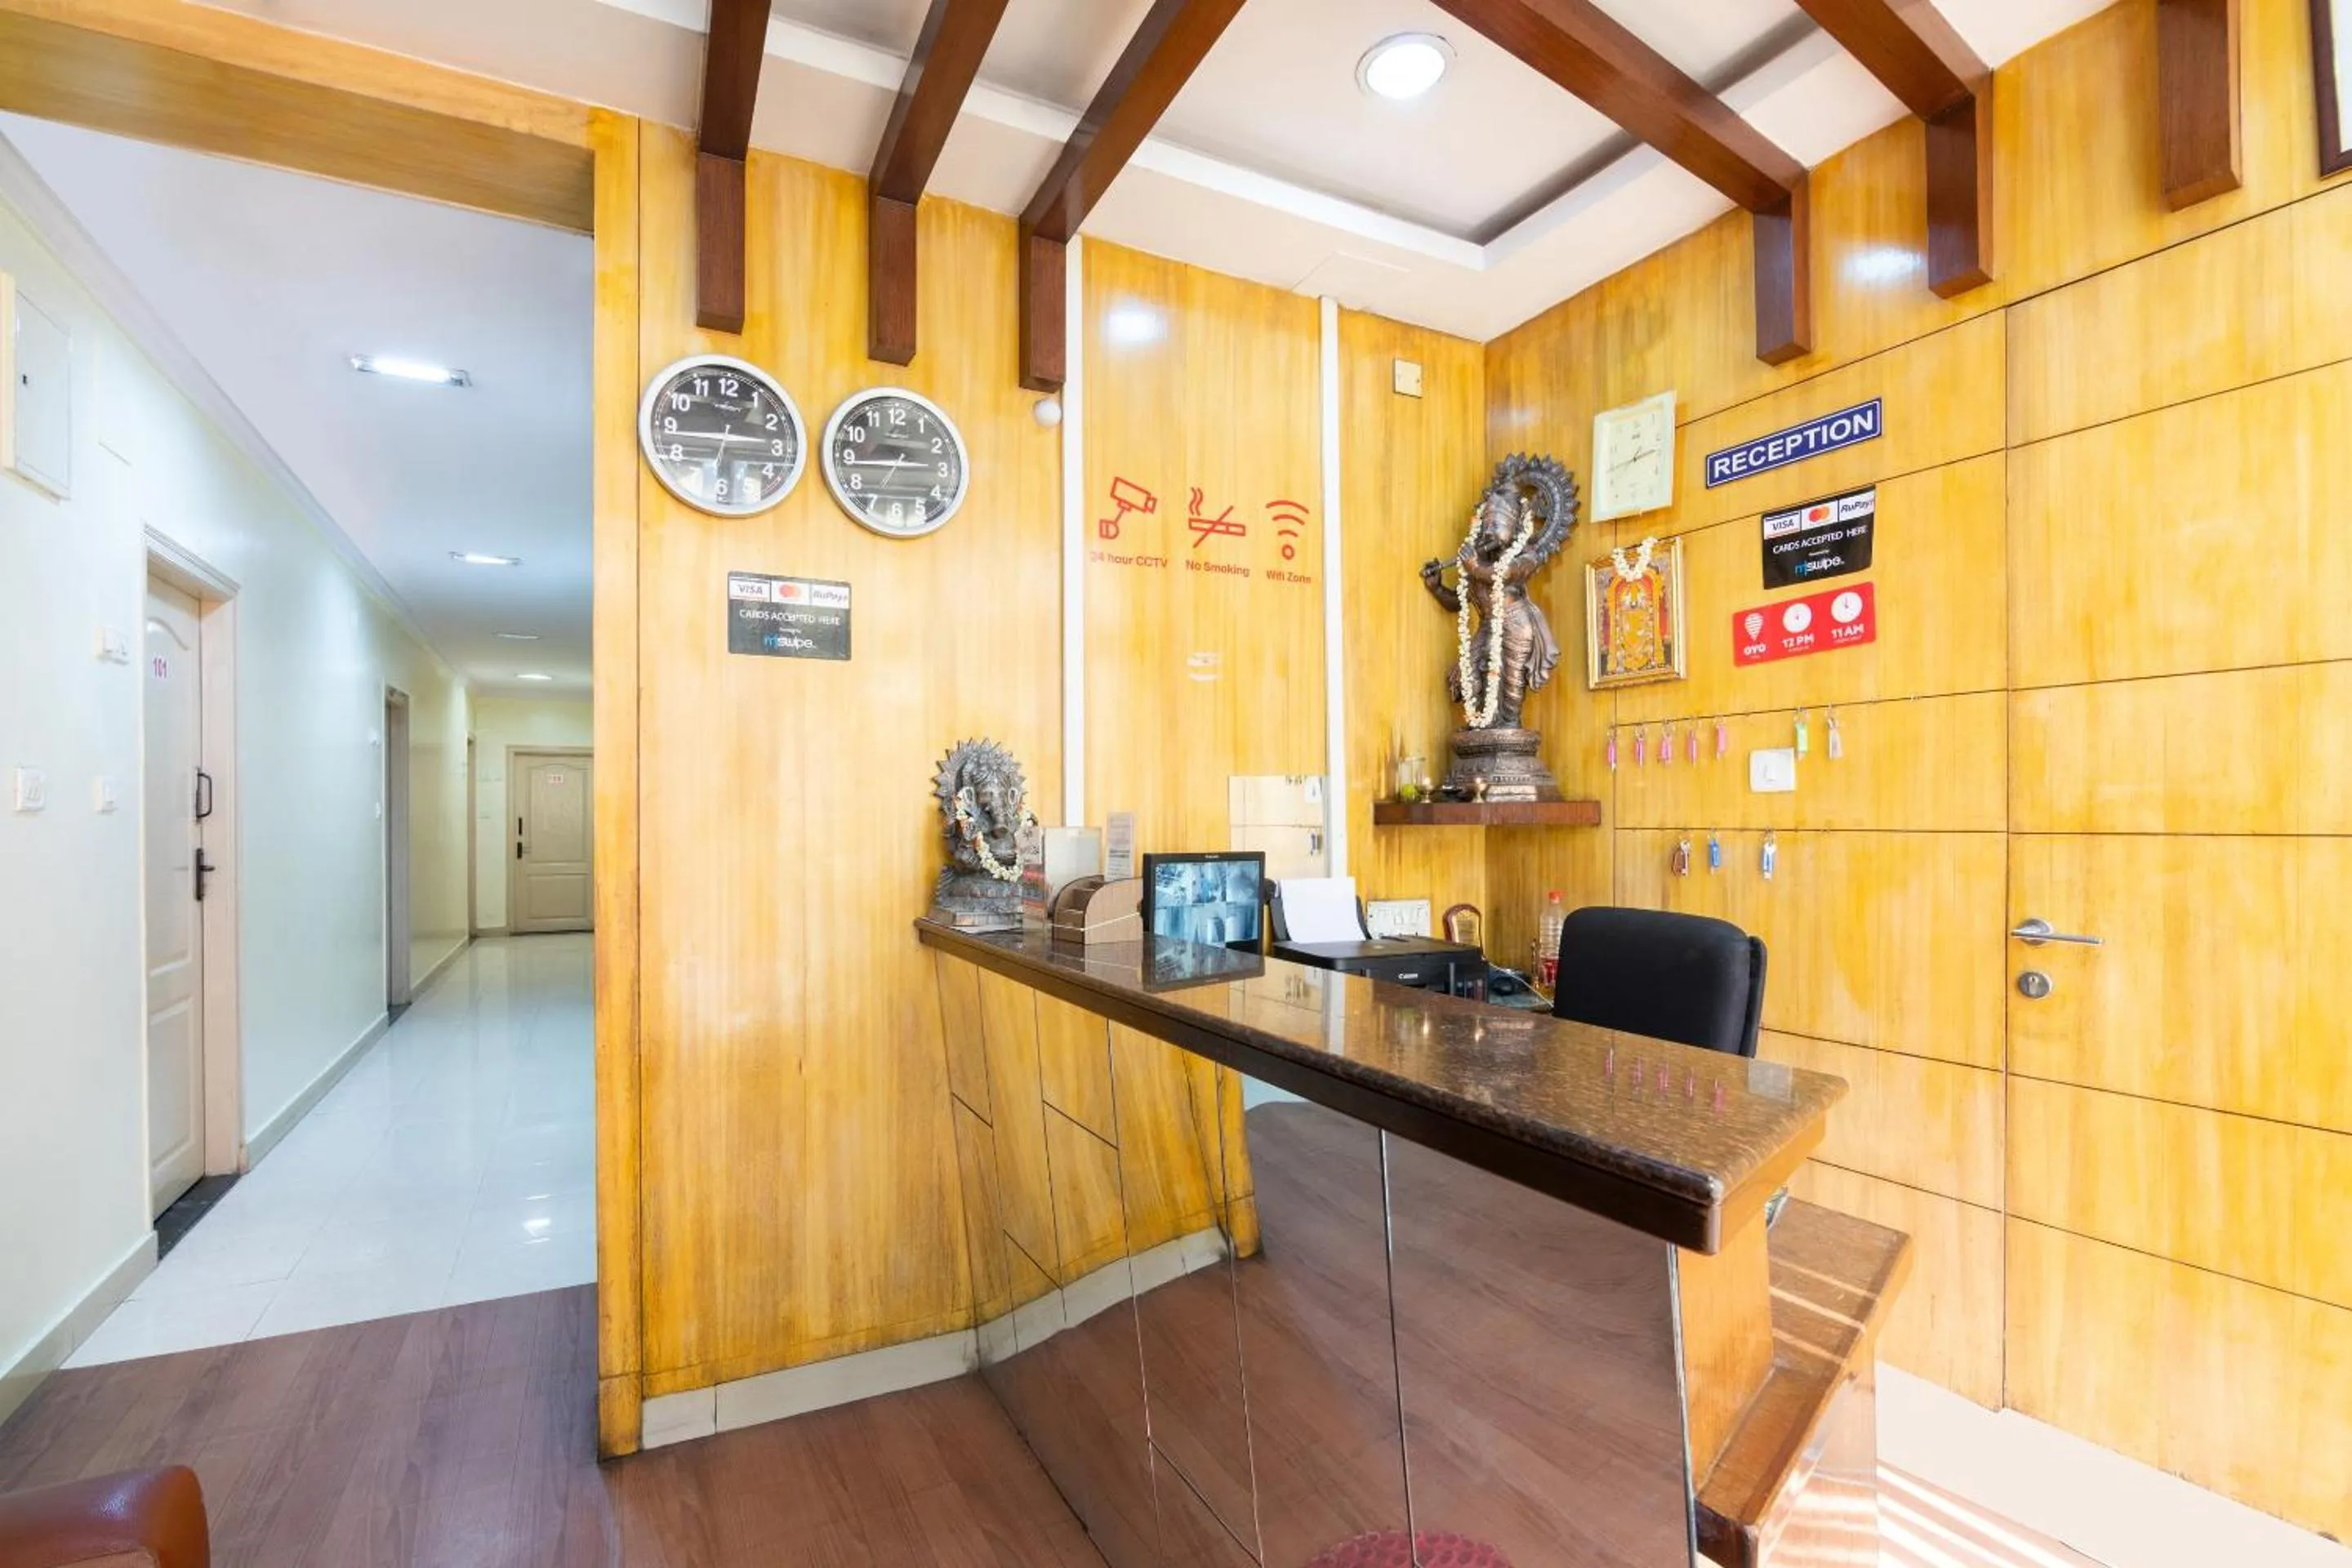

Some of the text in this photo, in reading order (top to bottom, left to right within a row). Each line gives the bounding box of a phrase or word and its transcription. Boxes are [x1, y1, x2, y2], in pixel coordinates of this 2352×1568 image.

[694, 378, 709, 397] 11
[719, 377, 738, 397] 12
[671, 393, 690, 412] 10
[752, 391, 759, 408] 1
[664, 416, 677, 433] 9
[765, 413, 778, 430] 2
[866, 410, 880, 427] 11
[888, 408, 906, 425] 12
[918, 417, 924, 434] 1
[848, 425, 866, 443] 10
[670, 443, 683, 461] 8
[771, 439, 783, 457] 3
[931, 438, 942, 454] 2
[1714, 410, 1873, 479] RECEPTION
[843, 449, 855, 465] 9
[762, 463, 774, 479] 4
[938, 462, 948, 478] 3
[715, 479, 728, 495] 6
[851, 474, 862, 490] 8
[931, 485, 941, 501] 4
[868, 494, 878, 510] 7
[891, 503, 902, 517] 6
[915, 499, 926, 515] 5
[1772, 519, 1794, 531] VISA
[1773, 541, 1800, 555] CARDS
[1802, 531, 1843, 548] ACCEPTED
[1846, 525, 1868, 538] HERE
[1107, 554, 1134, 565] hour
[1136, 555, 1168, 568] CCTV
[1185, 560, 1250, 577] No Smoking
[1287, 572, 1312, 584] Zone
[738, 585, 763, 595] VISA
[739, 609, 769, 621] CARDS
[771, 612, 815, 623] ACCEPTED
[1831, 623, 1865, 639] 11 AM
[1782, 634, 1815, 648] 12 PM
[1744, 644, 1766, 656] OYO
